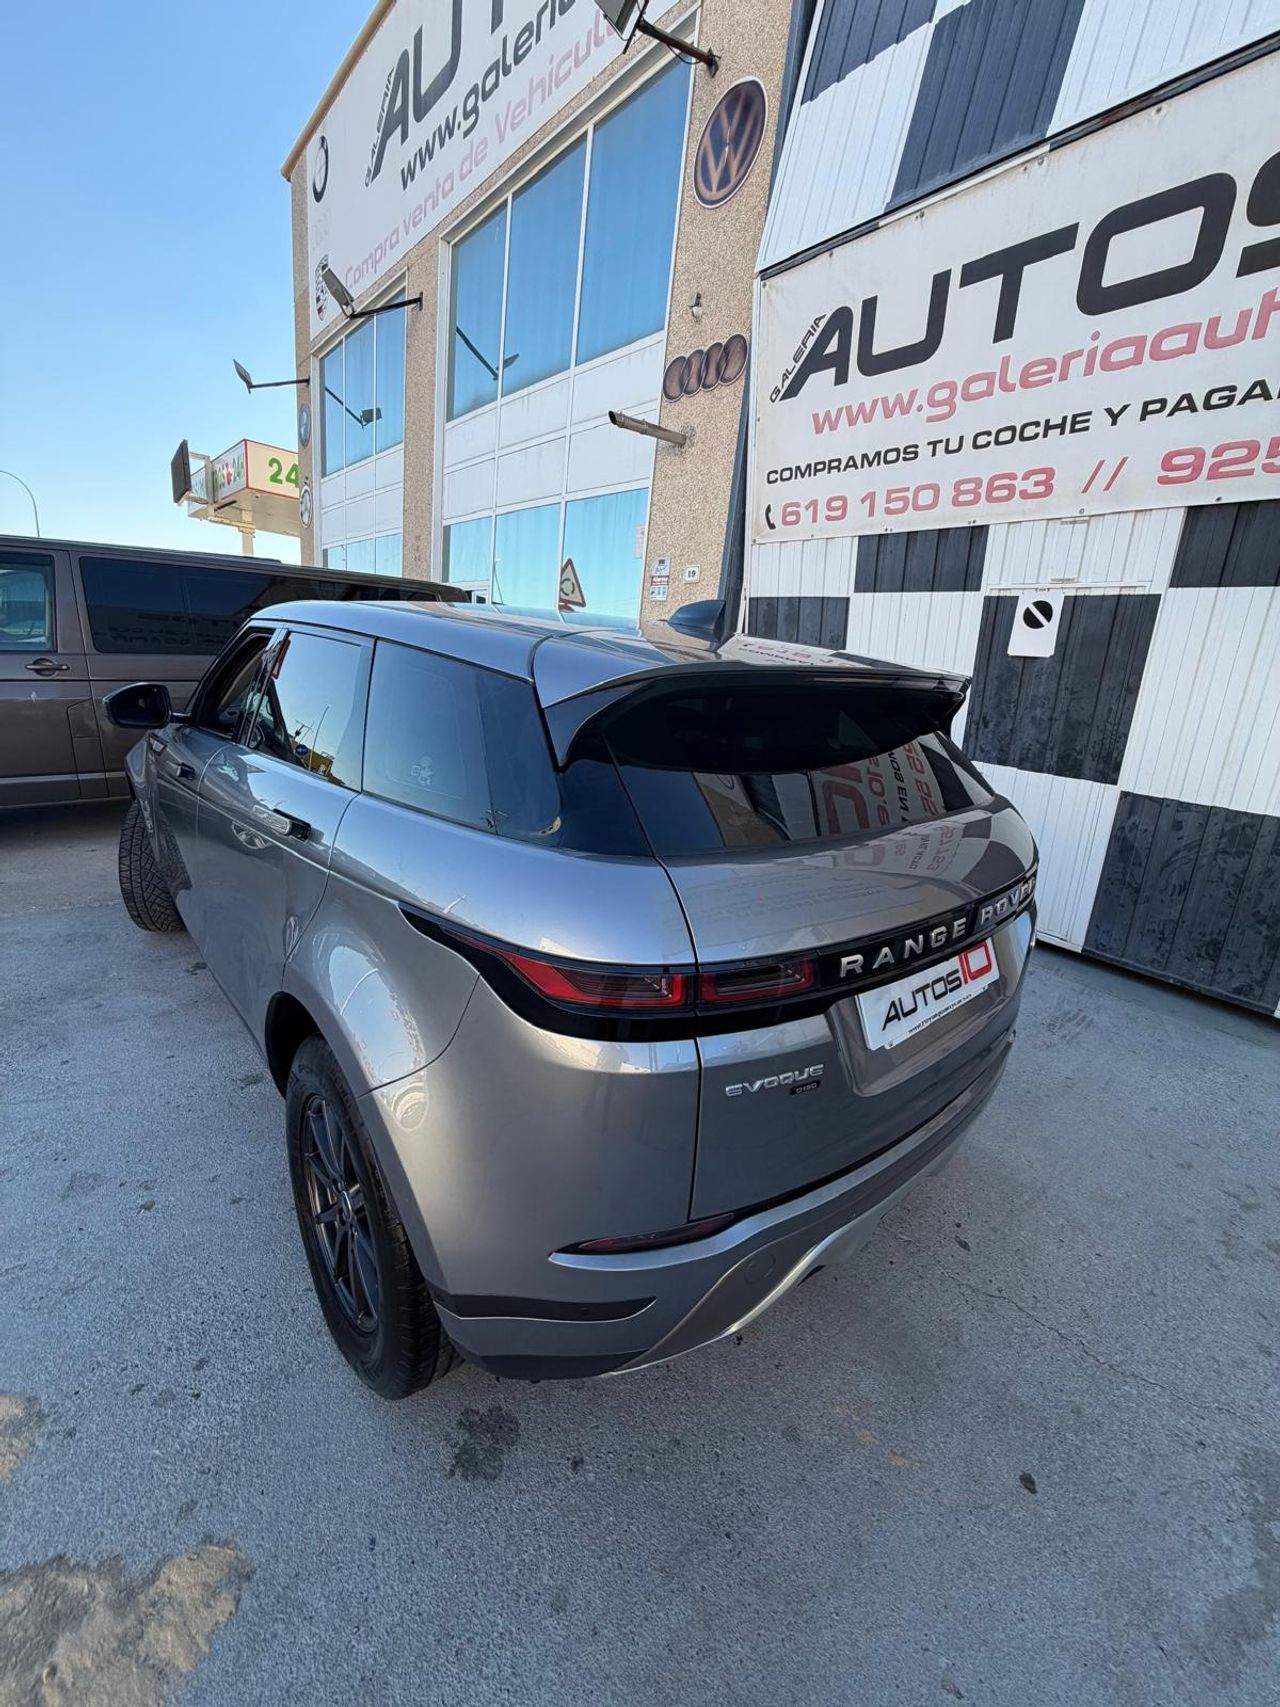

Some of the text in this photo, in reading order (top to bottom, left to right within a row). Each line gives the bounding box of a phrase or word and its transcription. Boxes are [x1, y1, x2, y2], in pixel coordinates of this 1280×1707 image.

[371, 0, 503, 183] AU
[346, 10, 616, 288] Compra venta de Vehicul
[769, 314, 827, 403] GALERIA
[767, 379, 1280, 484] COMPRAMOS TU COCHE Y PAGA
[781, 495, 848, 526] 619
[861, 483, 940, 517] 150
[952, 467, 1055, 507] 863
[687, 570, 696, 578] 19
[839, 917, 967, 978] RANGE
[882, 940, 992, 1032] AUTOS10
[725, 1064, 824, 1097] EVOQUE
